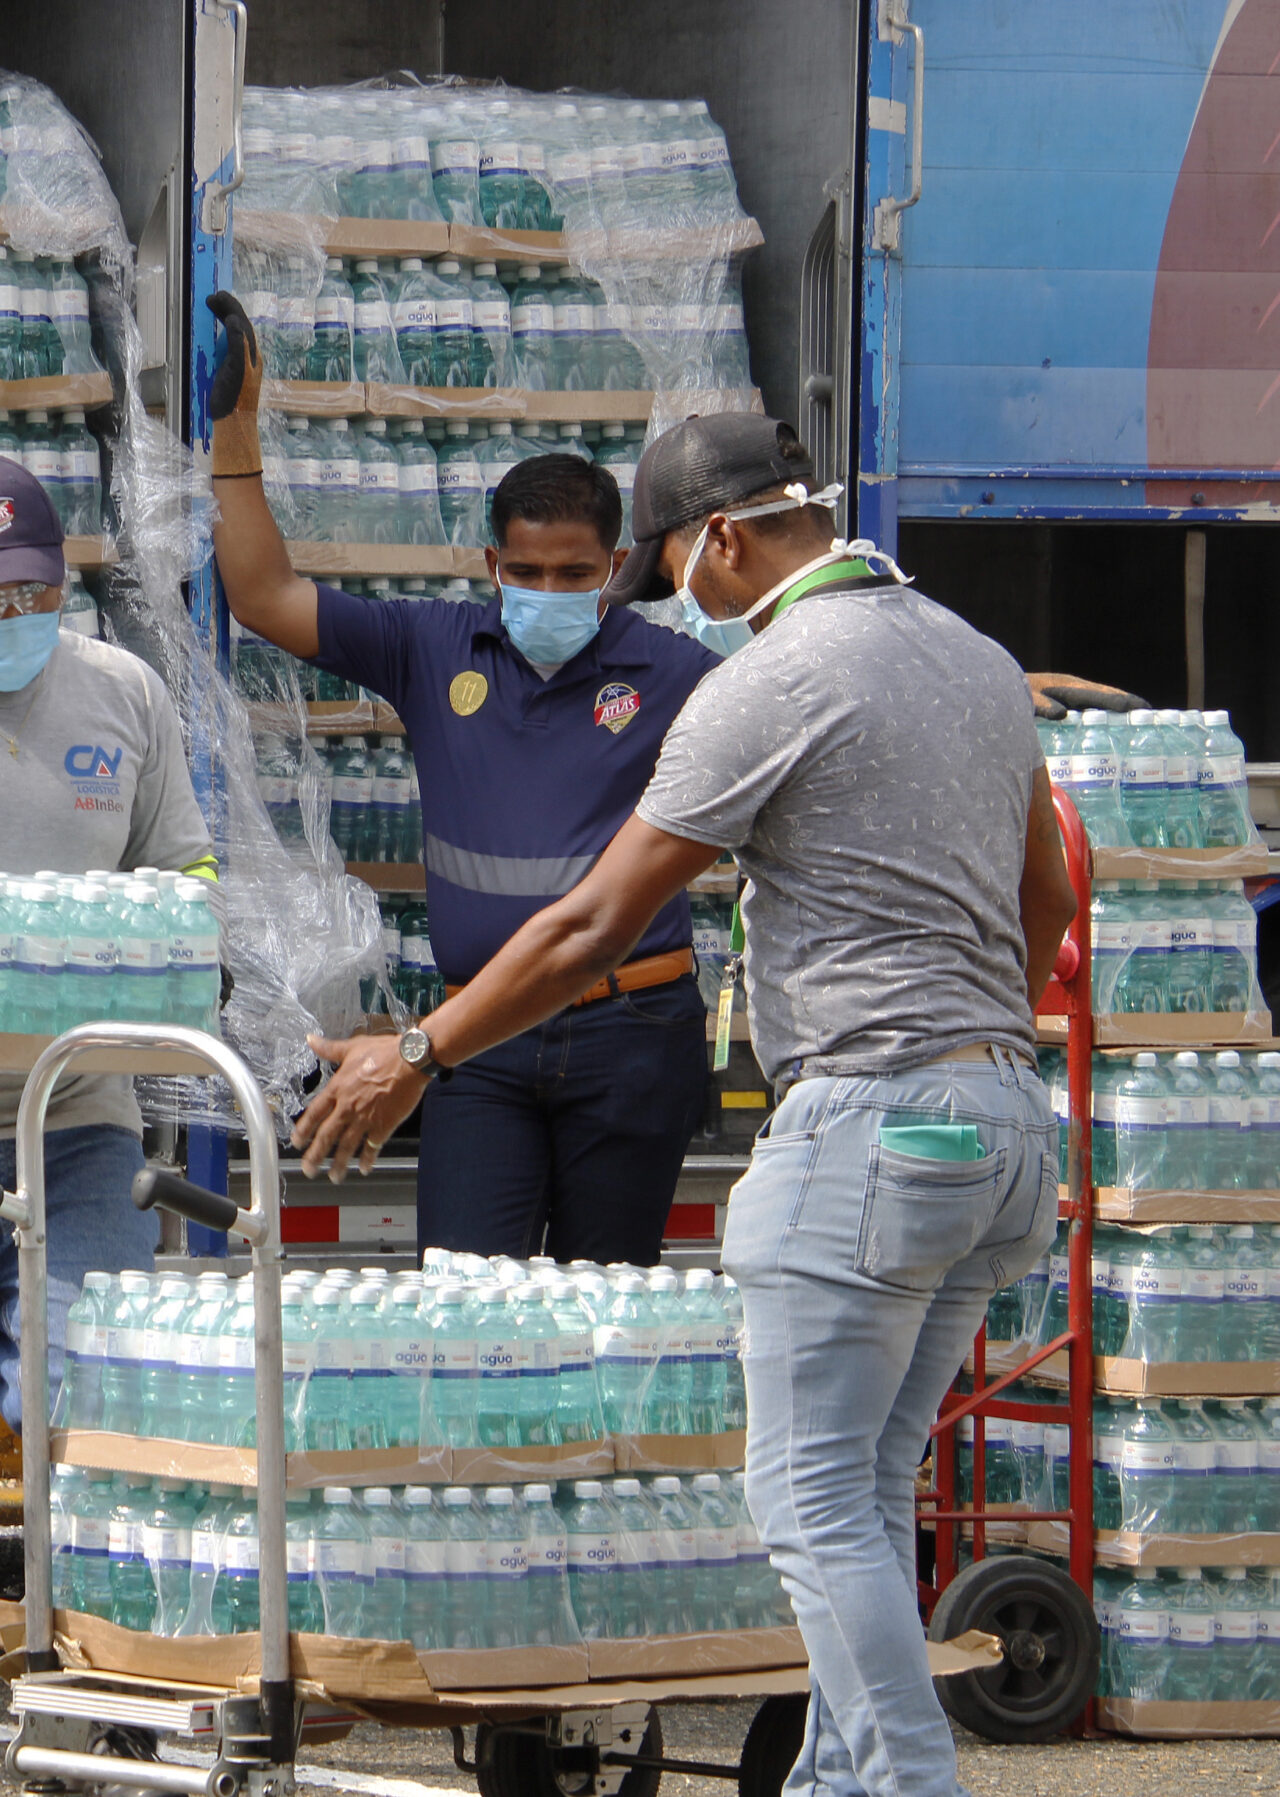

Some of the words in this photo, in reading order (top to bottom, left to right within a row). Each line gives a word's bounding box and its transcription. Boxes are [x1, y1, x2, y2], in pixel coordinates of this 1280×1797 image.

[600, 698, 636, 721] ATLAS
[64, 744, 123, 778] CN
[1051, 767, 1071, 779] agu
[1088, 765, 1116, 778] agua
[1228, 1281, 1258, 1292] agua
[395, 1353, 428, 1365] agua
[480, 1355, 513, 1367] agua
